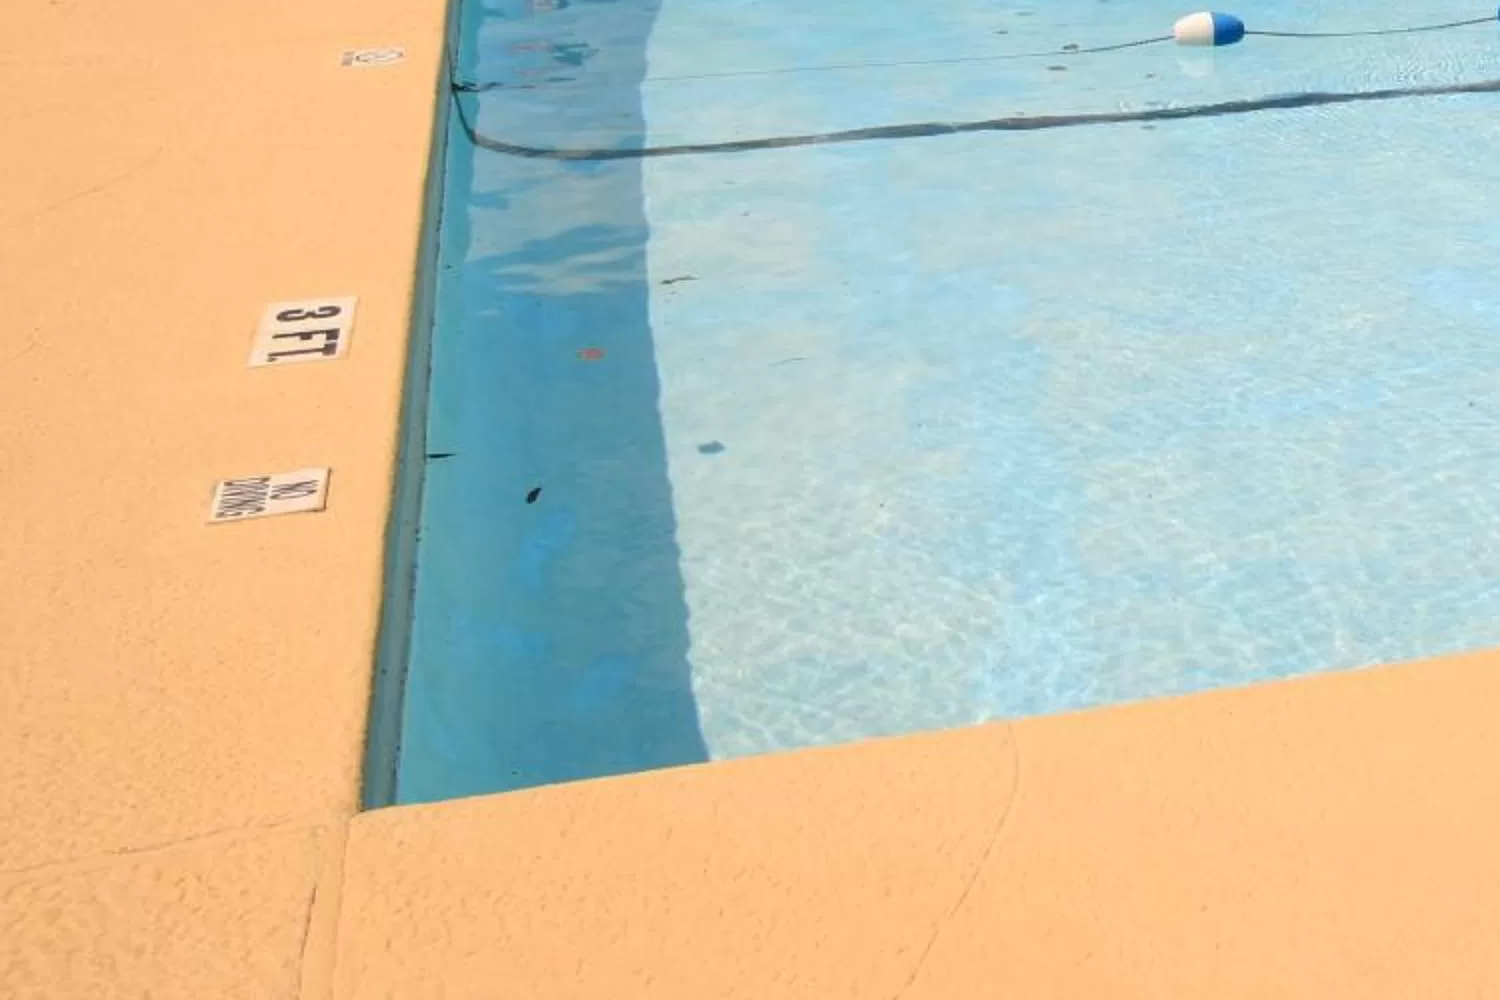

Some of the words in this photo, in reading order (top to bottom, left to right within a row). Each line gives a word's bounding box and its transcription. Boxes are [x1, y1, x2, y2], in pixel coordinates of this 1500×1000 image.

[276, 305, 342, 322] 3
[215, 476, 270, 518] DIVING
[269, 479, 320, 500] NO
